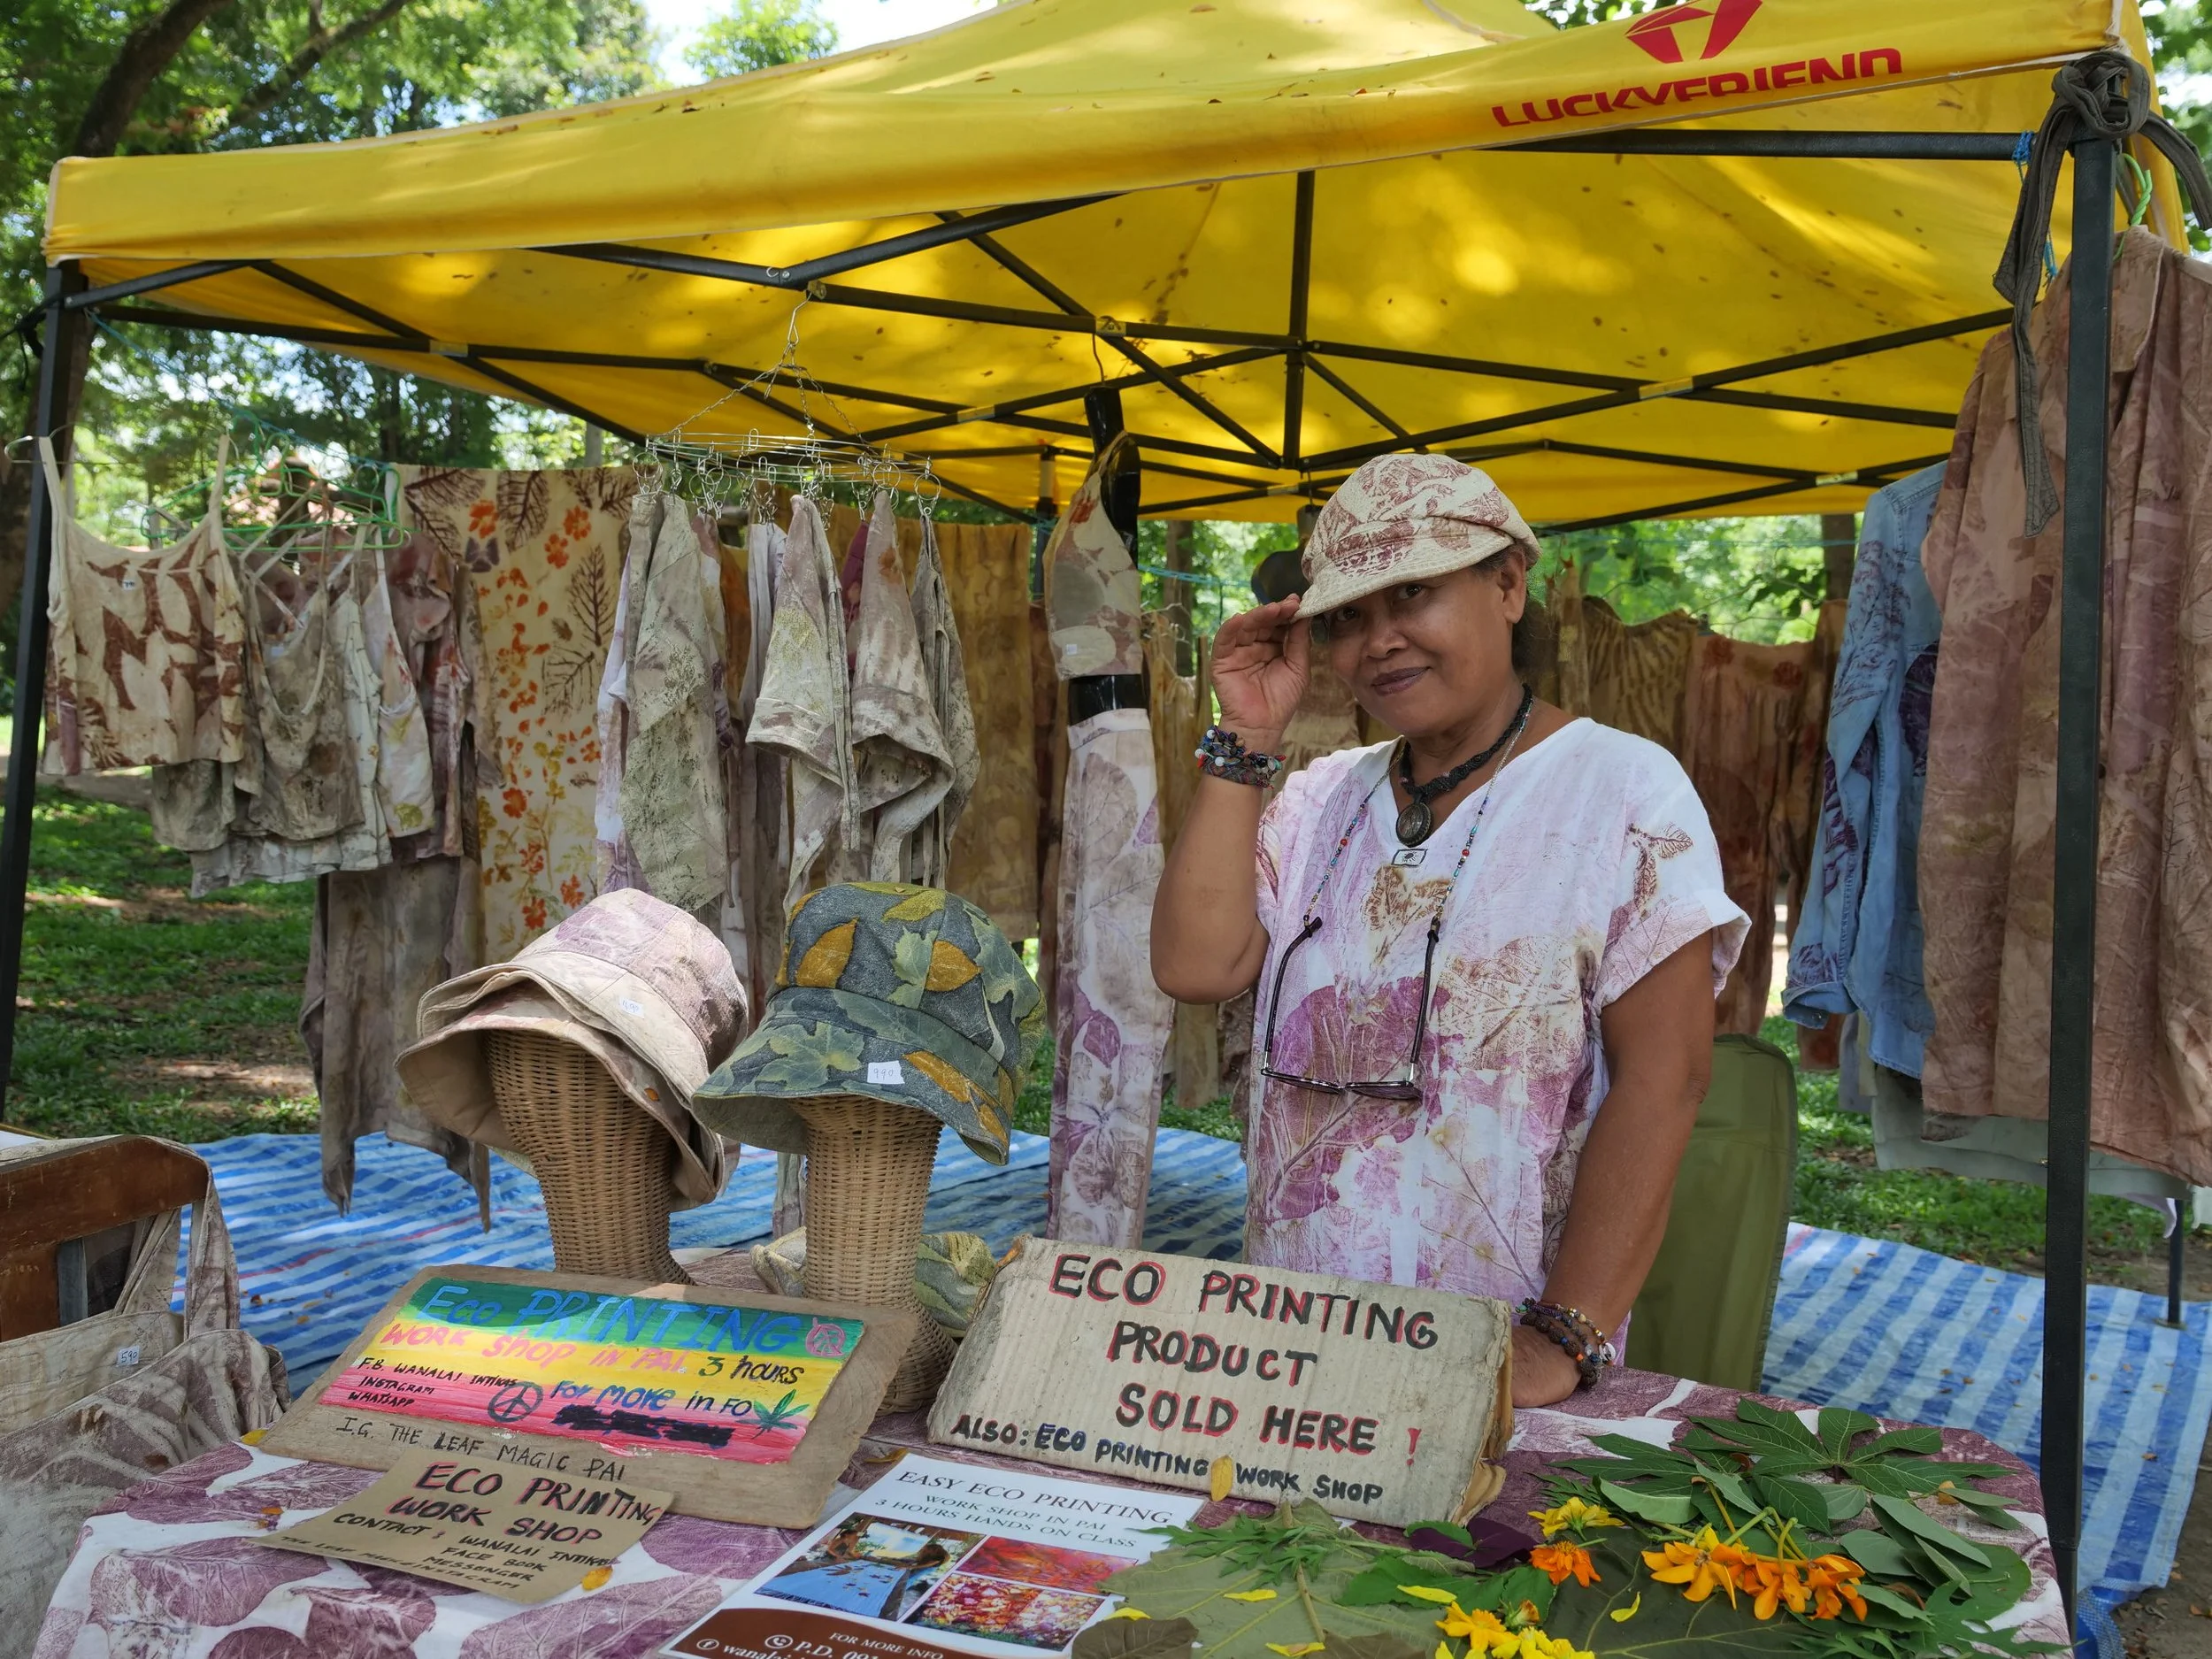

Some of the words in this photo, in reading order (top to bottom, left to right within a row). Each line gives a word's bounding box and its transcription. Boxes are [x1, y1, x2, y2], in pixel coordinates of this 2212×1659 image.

[505, 1289, 802, 1353] PRINTING
[1048, 1253, 1166, 1306] ECO
[1199, 1270, 1439, 1349] PRINTING
[121, 1350, 137, 1363] 590
[357, 1356, 386, 1373] F.B.
[380, 1323, 472, 1347] WORK
[698, 1356, 724, 1377] 3
[1106, 1320, 1318, 1387] PRODUCT
[348, 1390, 416, 1408] WHATSAPP
[1115, 1382, 1240, 1438] SOLD
[1258, 1404, 1379, 1455] HERE
[336, 1417, 373, 1439] I.G.
[389, 1423, 423, 1445] THE
[434, 1431, 485, 1455] LEAF
[496, 1442, 571, 1471] MAGIC
[582, 1457, 626, 1481] PAI
[1033, 1422, 1087, 1452] ECO
[1094, 1438, 1209, 1477] PRINTING
[1235, 1462, 1302, 1494] WORK
[1312, 1473, 1384, 1506] SHOP
[412, 1461, 503, 1496] ECO
[515, 1476, 664, 1526] PRINTING
[896, 1471, 964, 1490] EASY
[967, 1482, 1025, 1501] ECO
[1033, 1493, 1173, 1524] PRINTING
[926, 1494, 981, 1511] WORK
[987, 1506, 1041, 1520] SHOP
[1046, 1515, 1070, 1525] IN
[1075, 1520, 1106, 1531] PAI
[385, 1495, 493, 1526] WORK
[503, 1517, 603, 1546] SHOP
[892, 1501, 960, 1519] HOURS
[964, 1514, 1034, 1532] HANDS
[1039, 1526, 1071, 1538] ON
[1078, 1532, 1137, 1548] CLASS
[440, 1547, 494, 1562] FACE
[503, 1558, 549, 1572] BOOK
[829, 1632, 859, 1644] FOR
[861, 1639, 905, 1653] MORE
